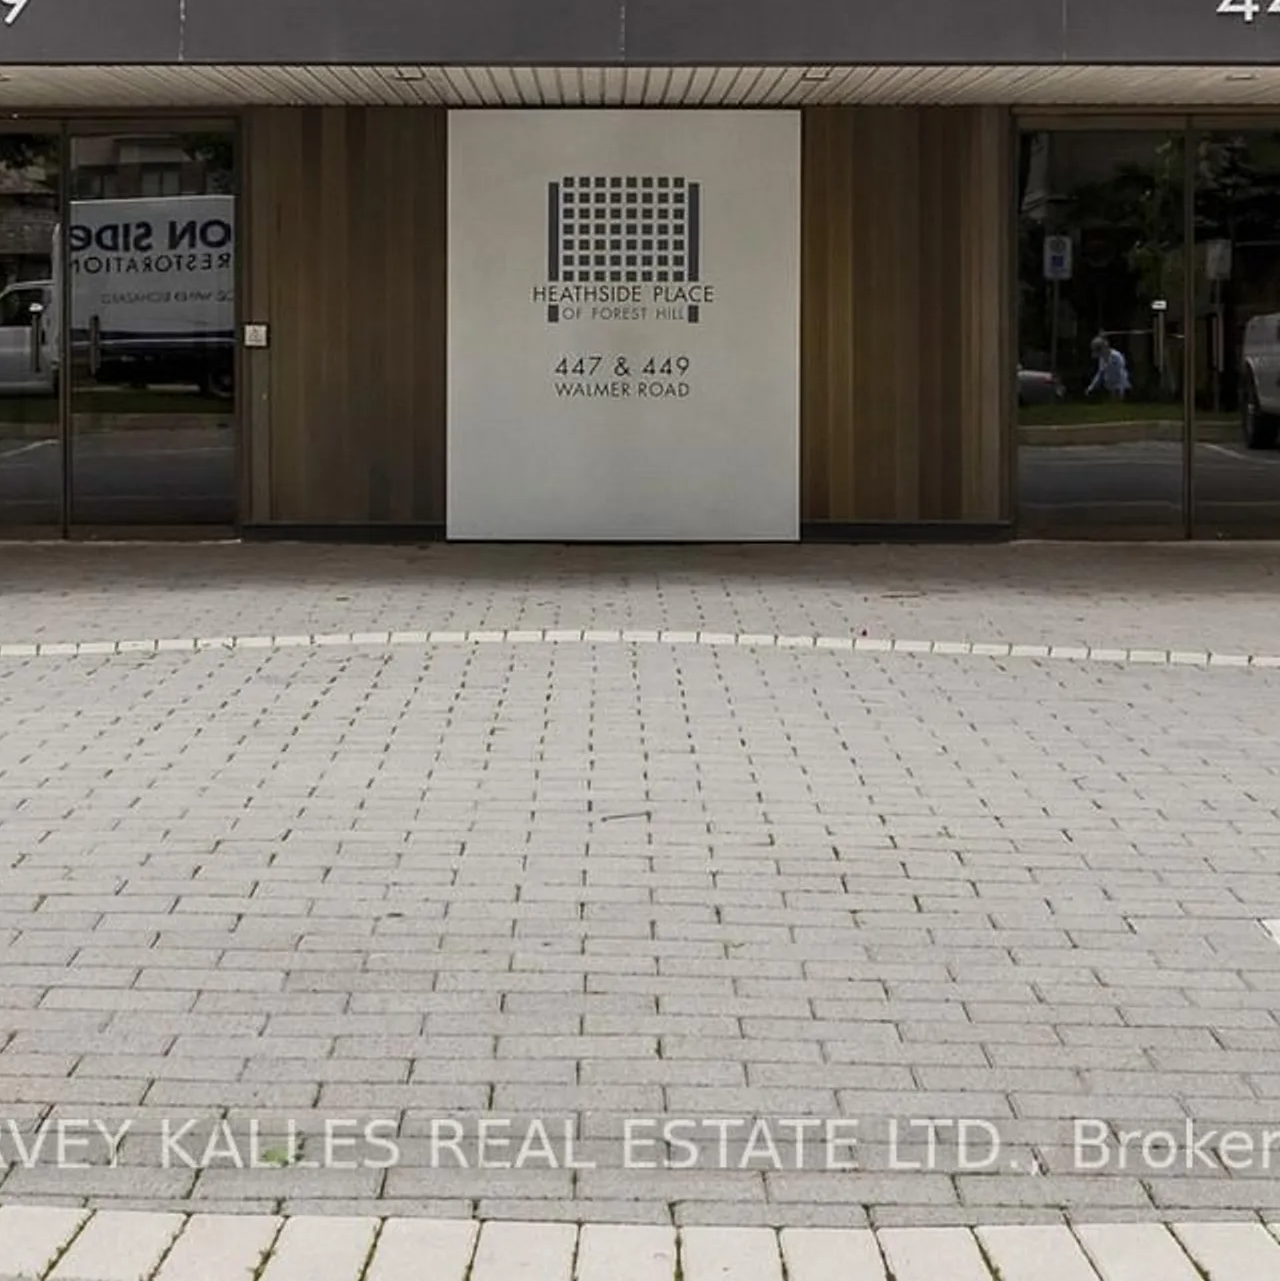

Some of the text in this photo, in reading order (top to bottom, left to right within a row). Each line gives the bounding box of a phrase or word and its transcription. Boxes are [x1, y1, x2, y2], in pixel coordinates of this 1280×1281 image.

[532, 285, 714, 303] HEATHSIDE PLACE
[562, 307, 685, 320] OF FOREST HILL
[554, 356, 690, 376] 447 & 449
[554, 382, 690, 398] WALMER ROAD
